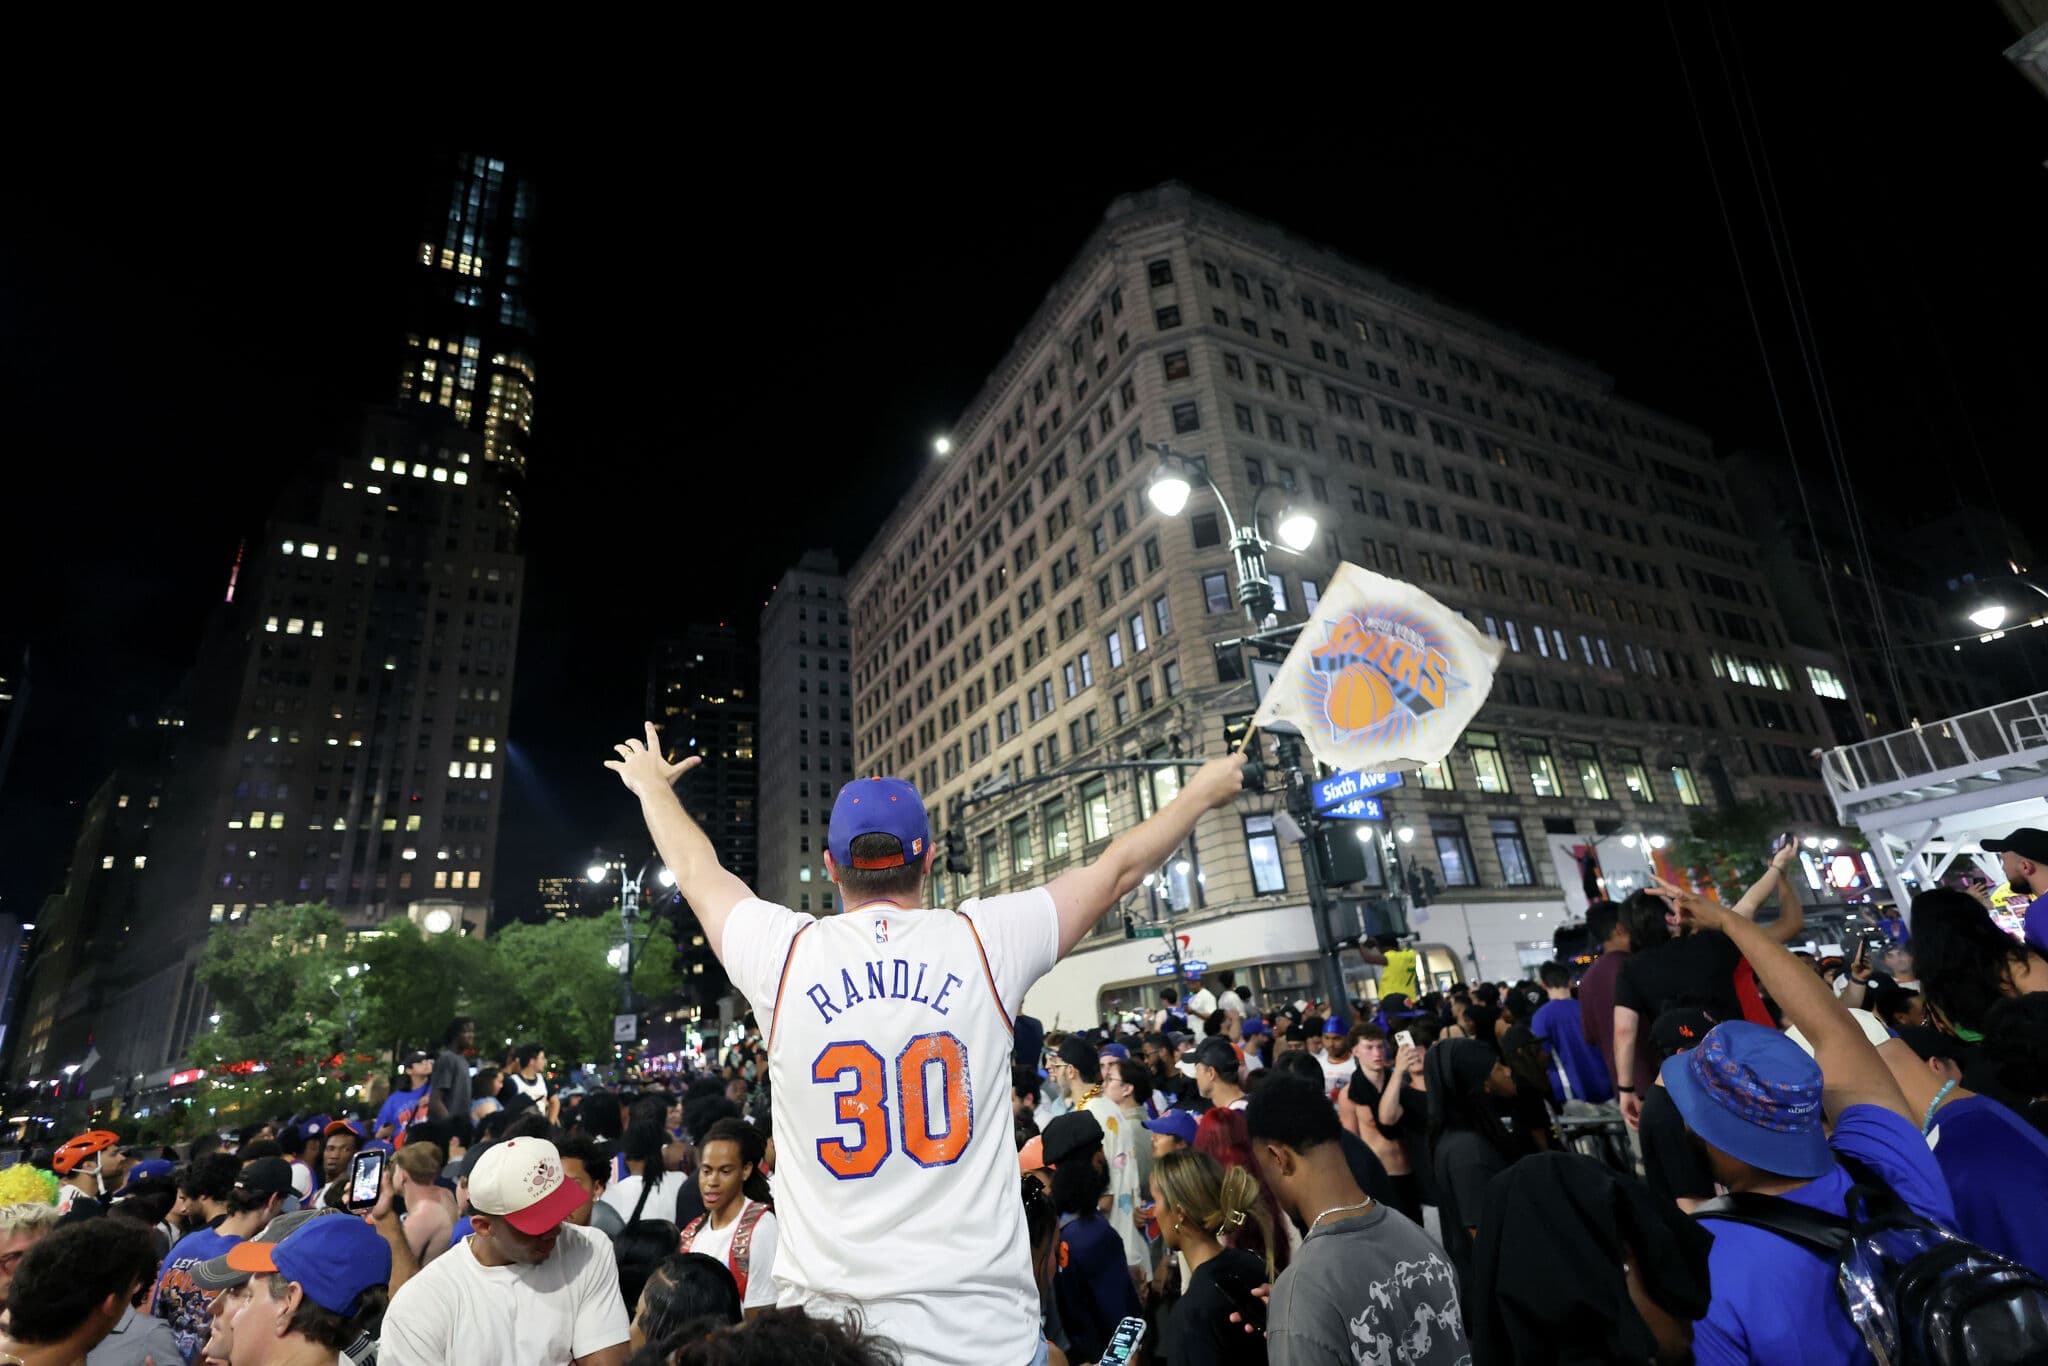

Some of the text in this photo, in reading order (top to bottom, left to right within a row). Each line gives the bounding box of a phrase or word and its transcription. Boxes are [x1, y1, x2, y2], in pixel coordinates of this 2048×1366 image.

[1311, 613, 1448, 709] KNICKS
[1322, 771, 1387, 802] Sixth Ave
[1366, 800, 1380, 817] St
[807, 958, 963, 1025] RANDLE
[812, 1030, 974, 1180] 30
